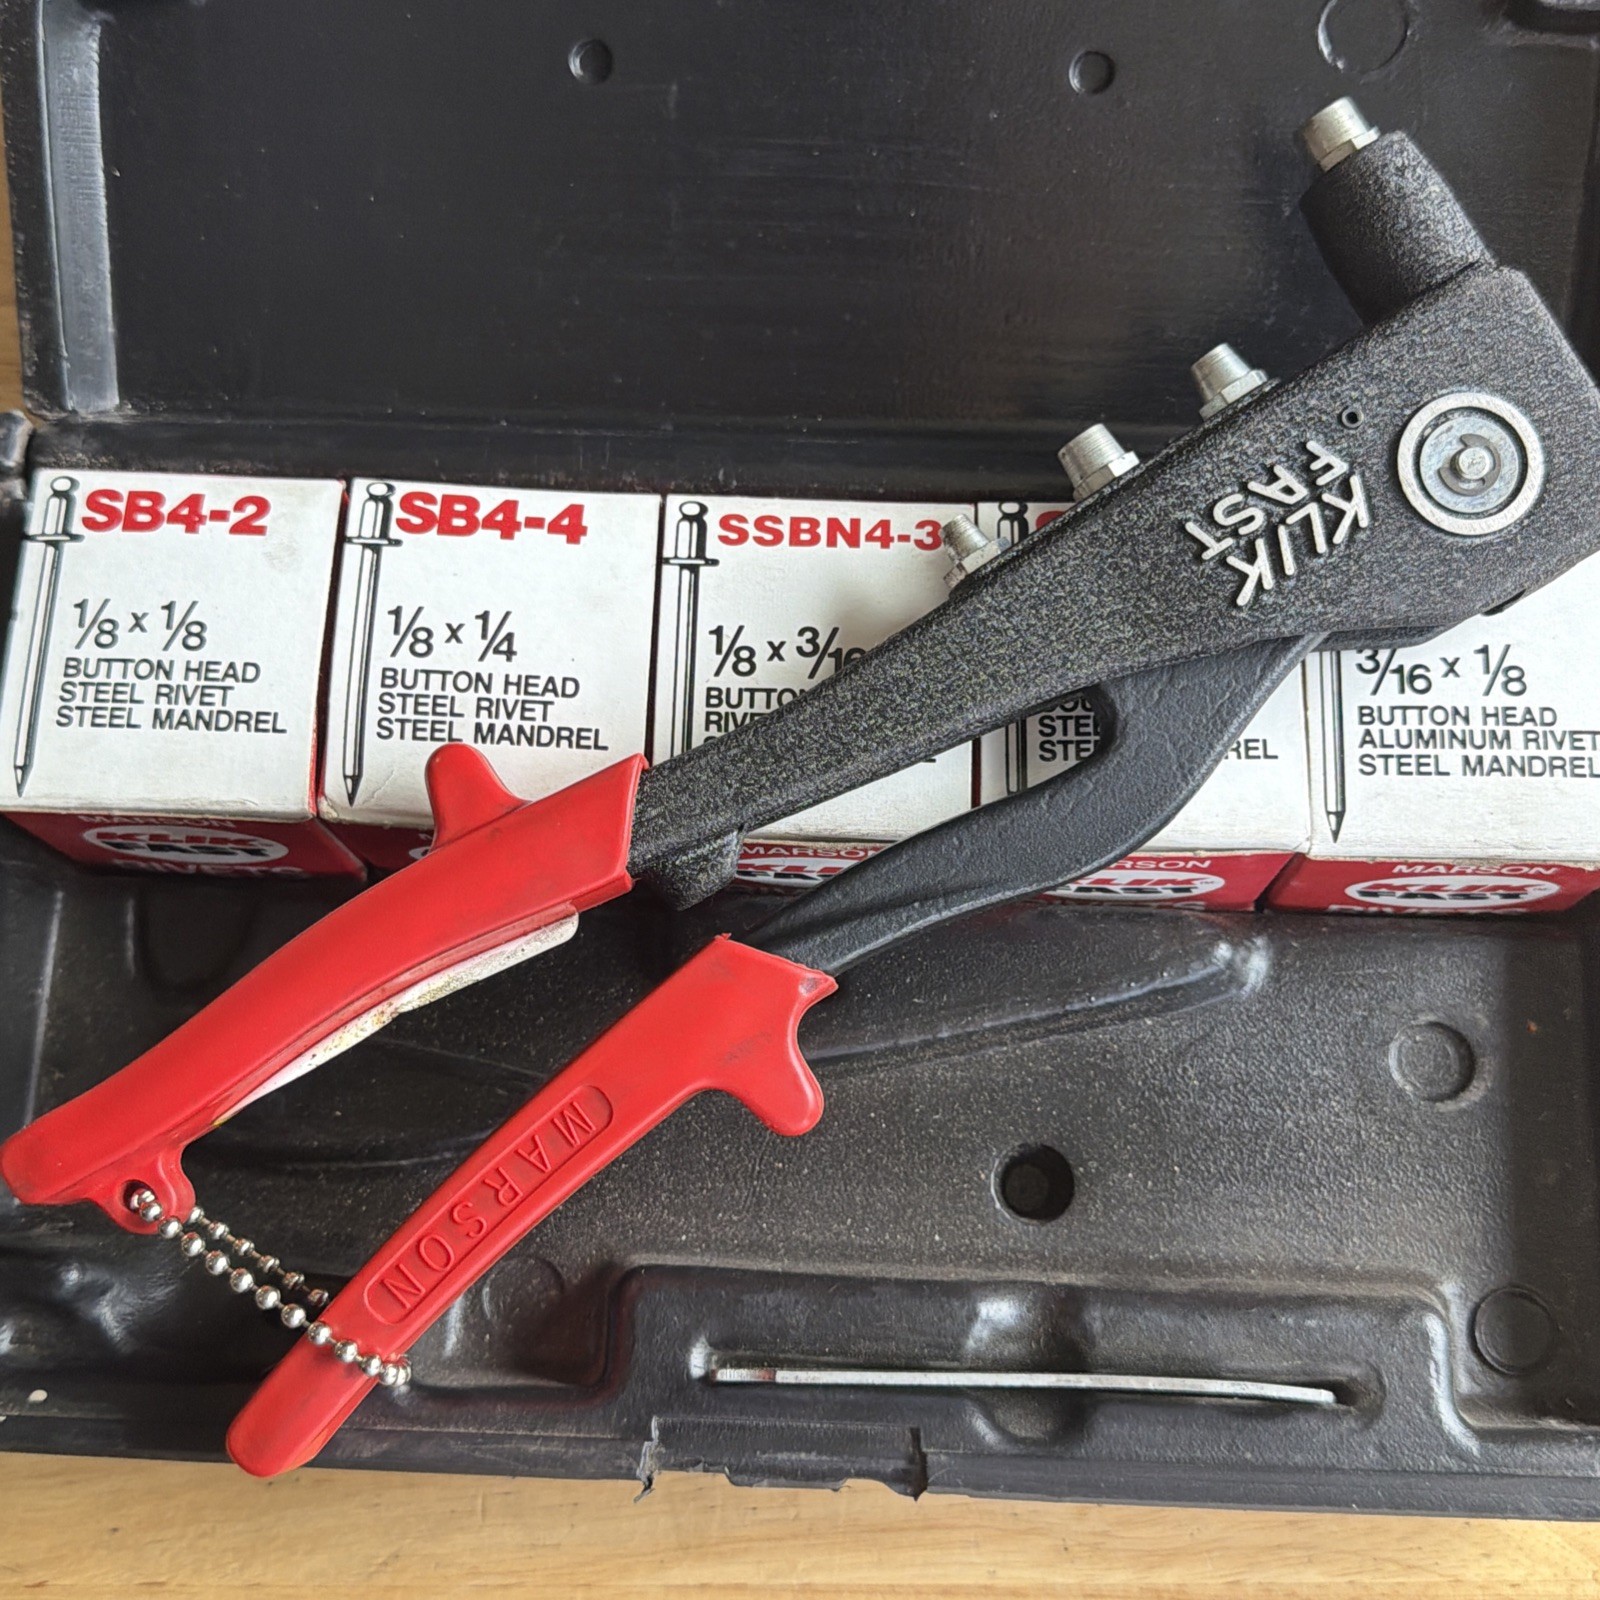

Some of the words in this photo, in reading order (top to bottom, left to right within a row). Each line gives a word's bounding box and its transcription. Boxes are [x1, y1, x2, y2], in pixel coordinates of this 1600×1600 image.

[82, 488, 271, 536] SB4-2
[1184, 440, 1348, 560] FAST
[395, 491, 588, 545] SB4-4
[718, 513, 943, 551] SSBN4-3
[1226, 474, 1369, 607] KLIK
[73, 598, 119, 650] 1/8
[128, 612, 148, 633] x
[160, 600, 207, 651] 1/8
[387, 605, 434, 658] 1/8
[445, 622, 465, 644] x
[474, 610, 517, 662] 1/4
[708, 625, 757, 678] 1/8
[766, 640, 787, 662] x
[63, 657, 175, 681] BUTTON
[184, 660, 261, 684] HEAD
[380, 667, 493, 694] BUTTON
[503, 673, 580, 698] HEAD
[1355, 648, 1432, 696] 3/16
[1440, 656, 1461, 678] x
[1474, 644, 1528, 697] 1/8
[59, 681, 144, 704] STEEL
[155, 684, 234, 707] RIVET
[378, 692, 465, 718] STEEL
[475, 697, 555, 722] RIVET
[706, 686, 807, 709] BUTTO
[56, 705, 142, 729] STEEL
[152, 708, 288, 734] MANDREL
[704, 711, 770, 732] RIV
[1038, 714, 1099, 737] STE
[1358, 705, 1471, 727] BUTTON
[1482, 706, 1557, 727] HEAD
[376, 717, 463, 743] STEEL
[473, 722, 610, 752] MANDREL
[1358, 729, 1512, 751] ALUMINUM
[1523, 730, 1600, 751] RIVET
[1038, 739, 1095, 762] STE
[1358, 754, 1451, 777] STEEL
[1462, 755, 1600, 778] MANDREL
[736, 863, 846, 873] KLI
[1109, 859, 1213, 869] RSON
[1391, 864, 1560, 876] MARSON
[1072, 877, 1210, 886] LIK
[1355, 889, 1529, 901] FAST
[1359, 883, 1545, 893] KLIK
[380, 1101, 597, 1310] MARSON
